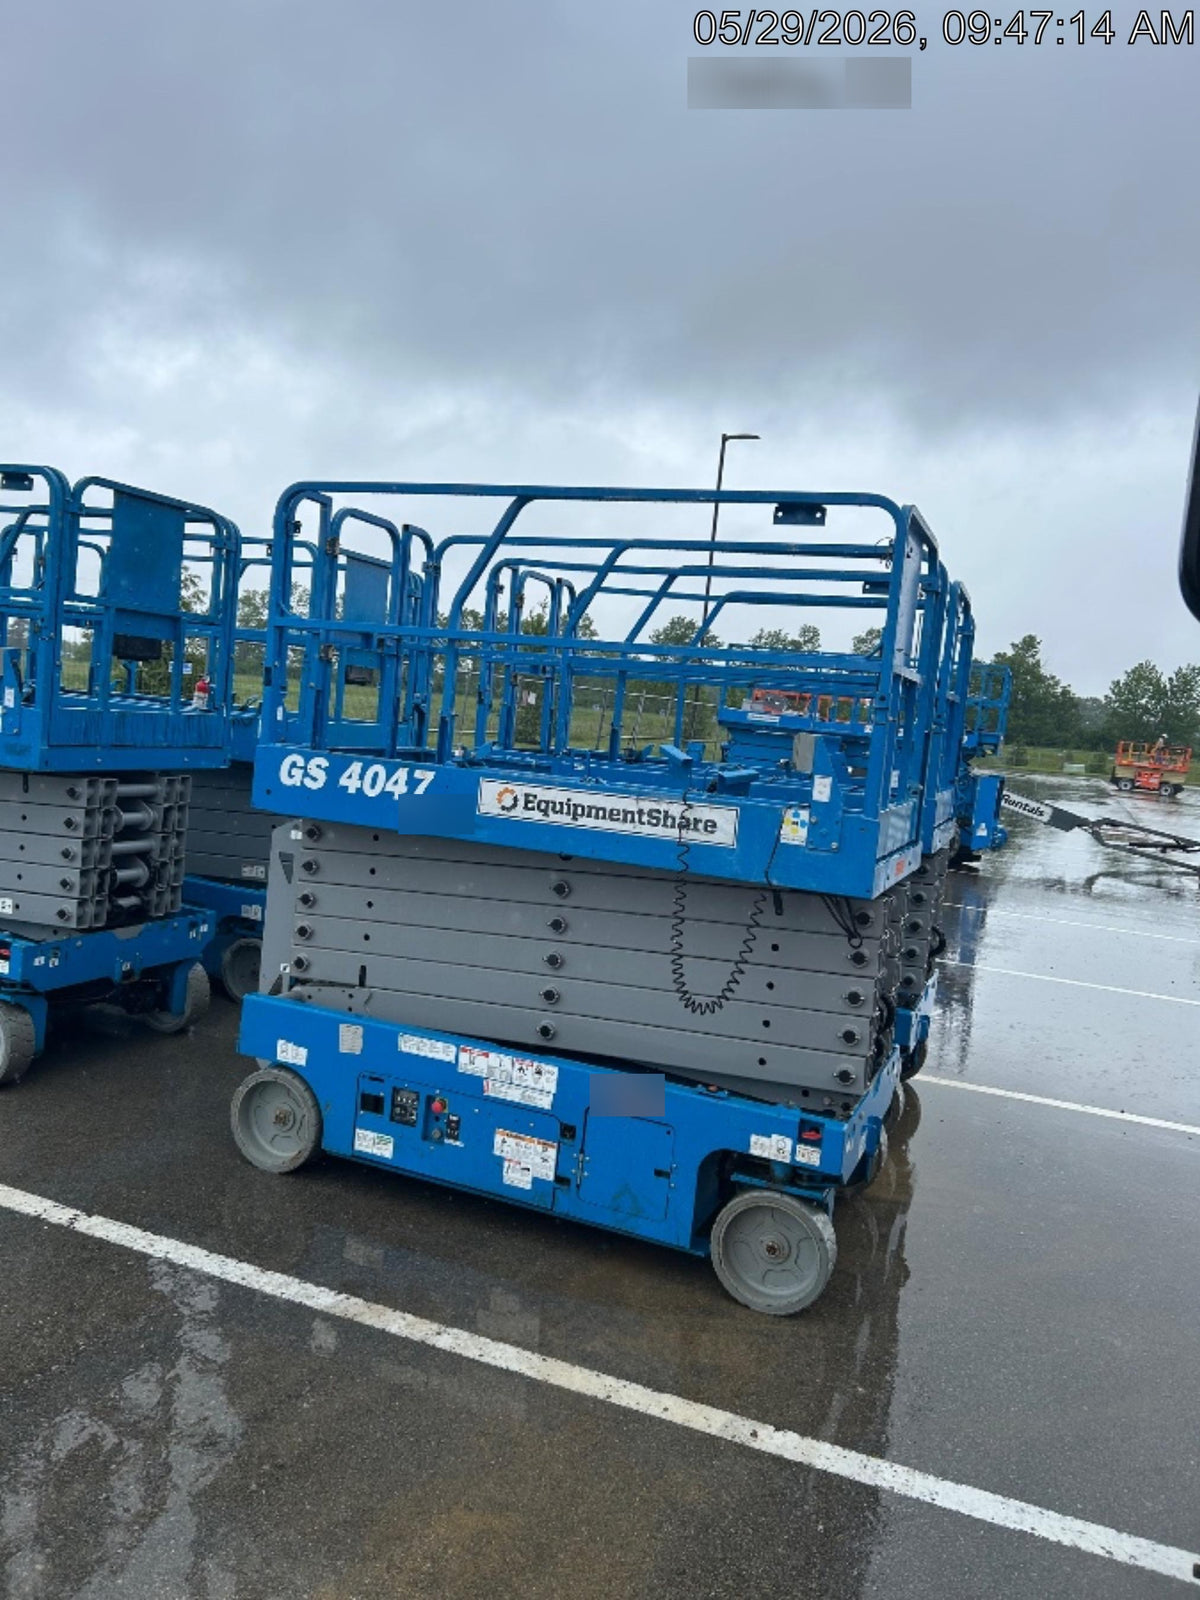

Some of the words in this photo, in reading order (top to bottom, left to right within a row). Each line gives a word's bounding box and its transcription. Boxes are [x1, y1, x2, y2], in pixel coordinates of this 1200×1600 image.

[279, 753, 330, 790] GS
[337, 761, 436, 800] 4047
[522, 792, 718, 835] EquipmentShare
